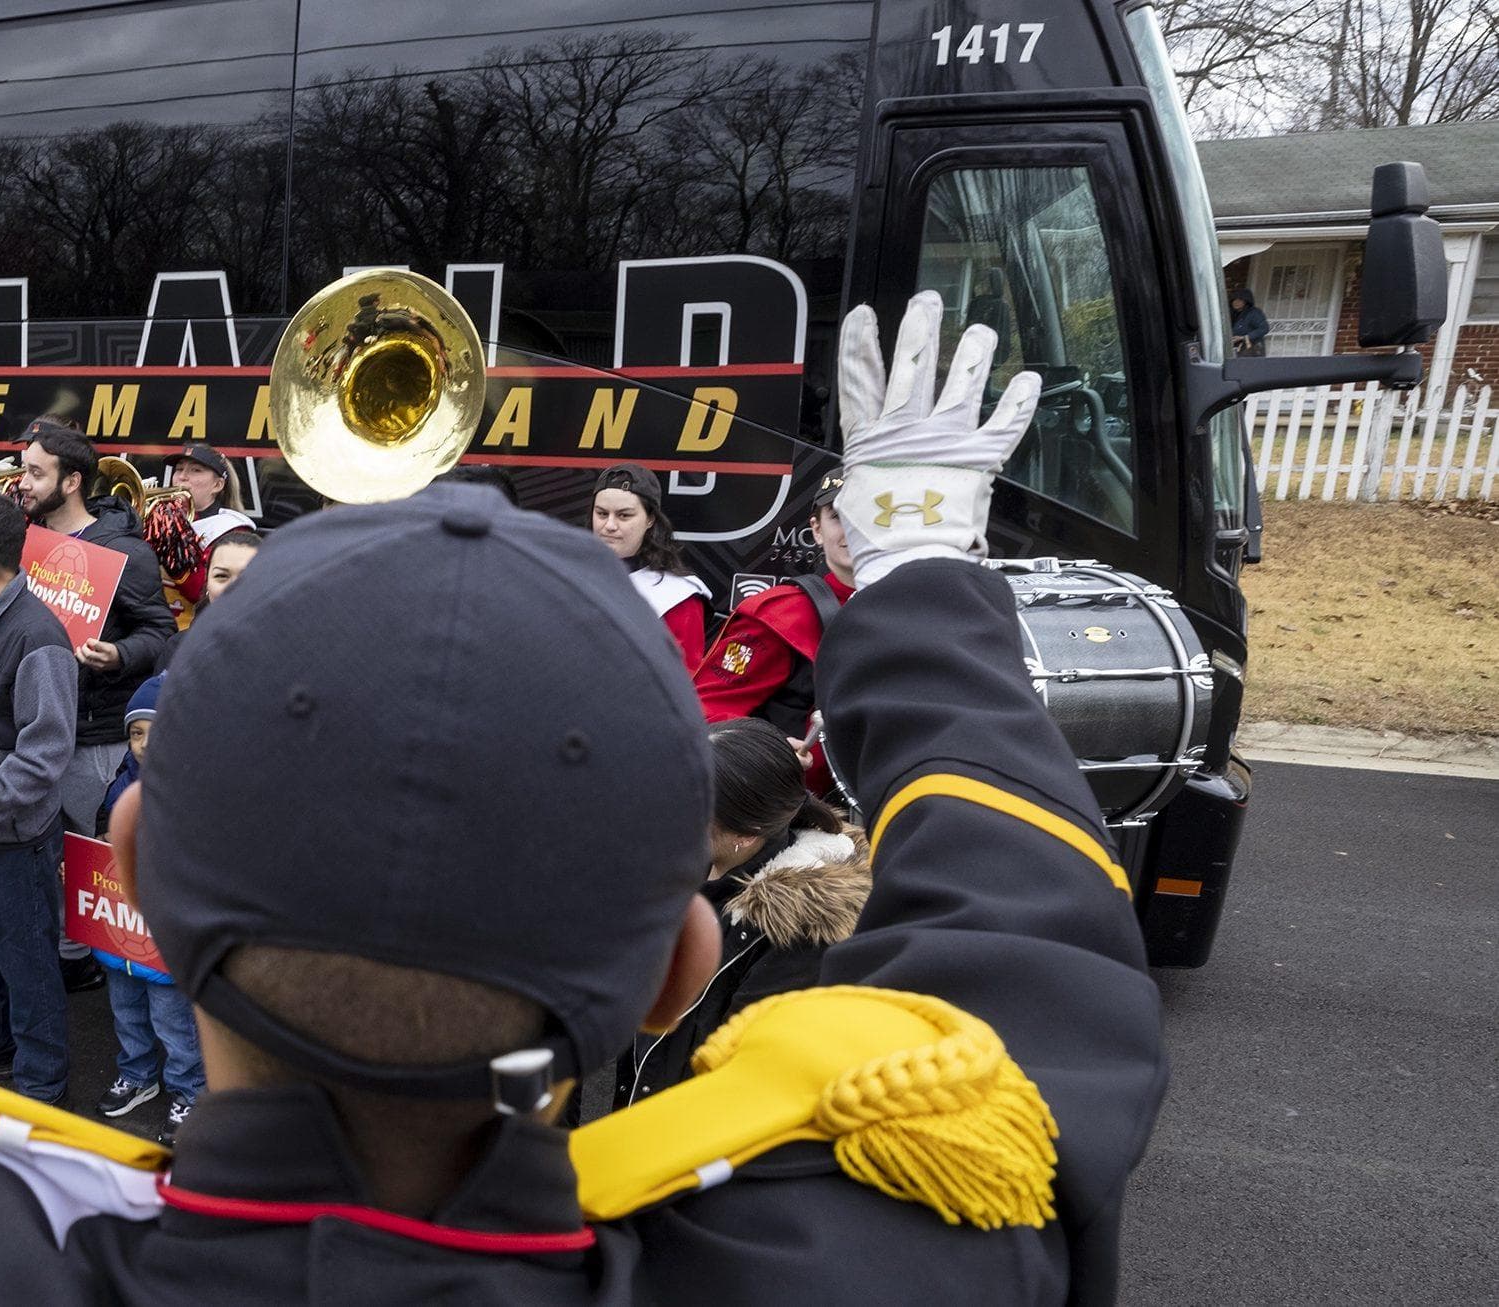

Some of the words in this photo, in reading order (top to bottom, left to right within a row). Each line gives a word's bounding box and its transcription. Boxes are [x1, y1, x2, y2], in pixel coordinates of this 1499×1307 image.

[931, 22, 1045, 66] 1417
[29, 560, 60, 585] Proud
[63, 570, 76, 591] To
[79, 578, 95, 598] Be
